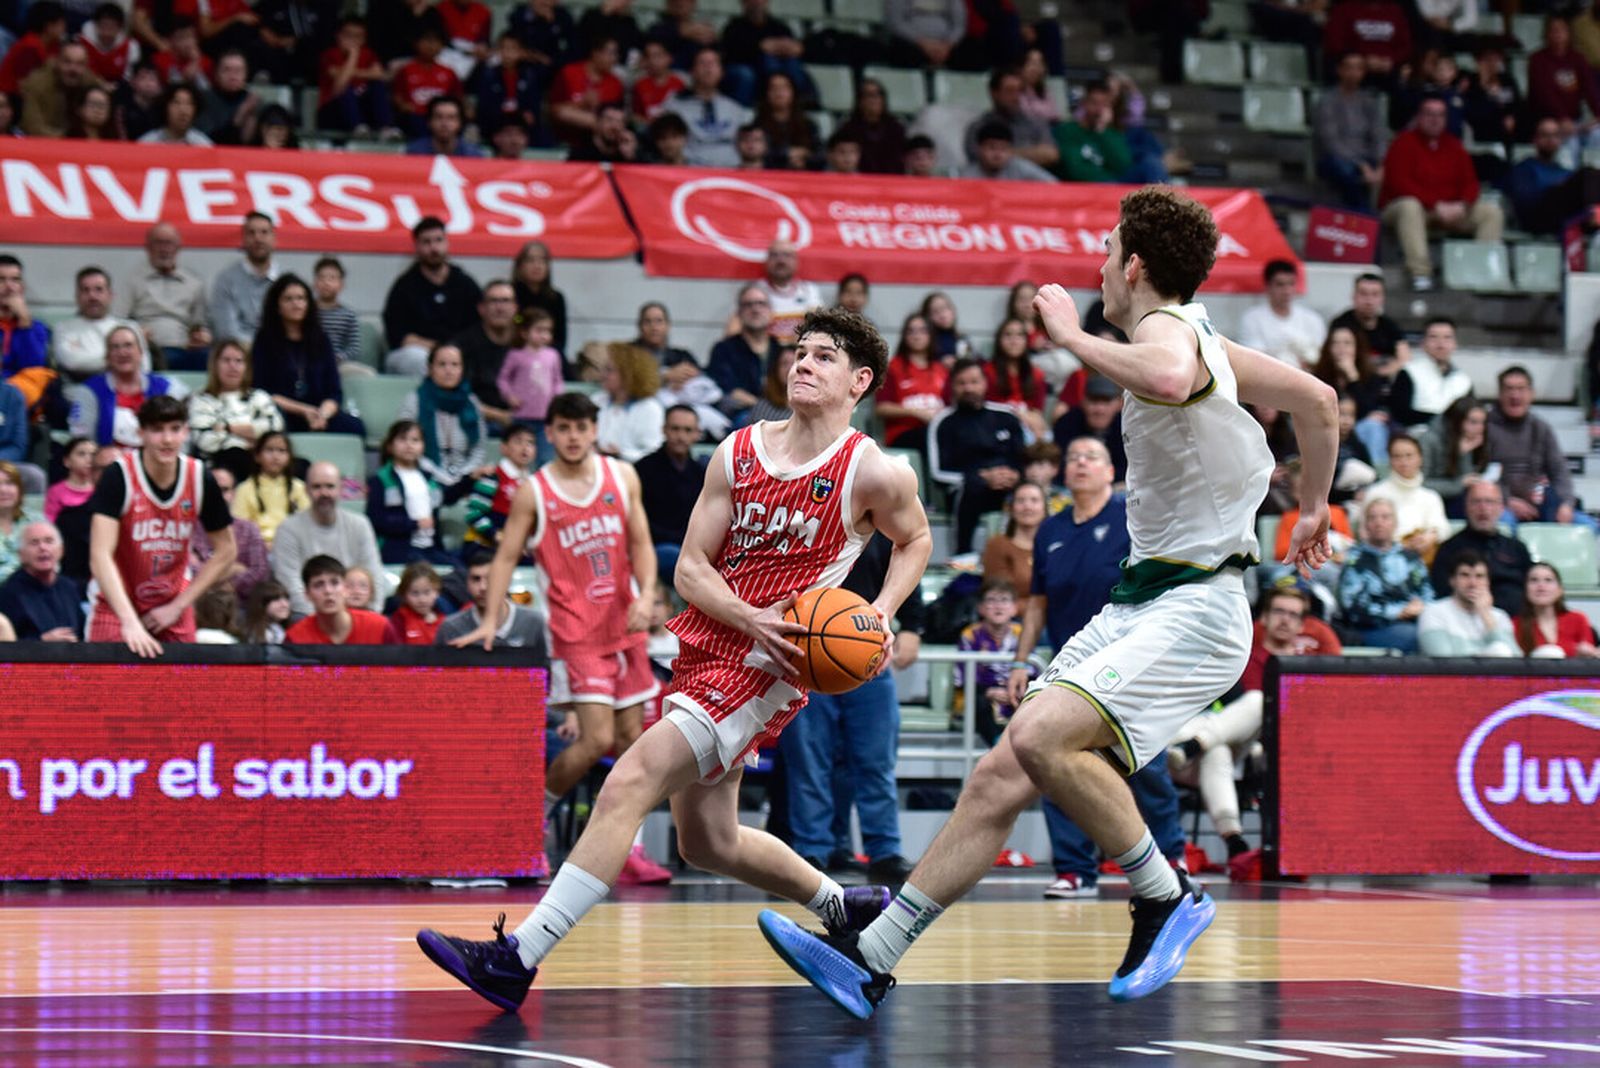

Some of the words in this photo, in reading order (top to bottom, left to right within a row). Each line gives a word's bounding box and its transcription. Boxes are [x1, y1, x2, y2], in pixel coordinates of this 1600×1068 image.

[1010, 224, 1073, 253] DE
[132, 518, 193, 541] UCAM
[558, 514, 622, 549] UCAM
[851, 614, 883, 632] Wil
[40, 757, 148, 815] por
[158, 742, 222, 798] el
[233, 741, 414, 799] sabor
